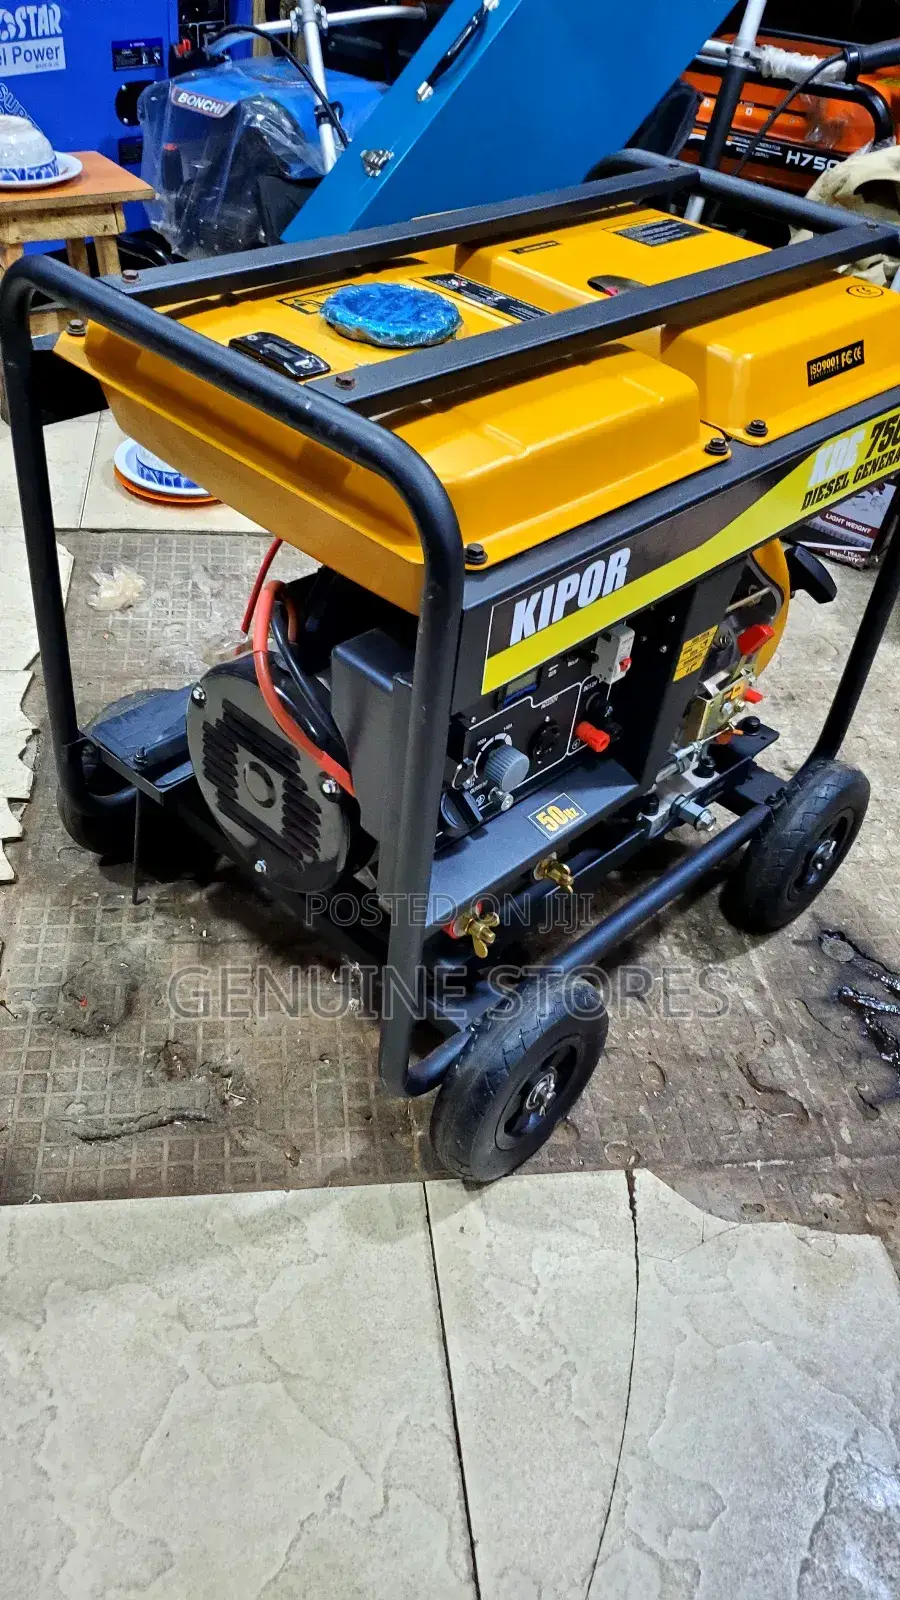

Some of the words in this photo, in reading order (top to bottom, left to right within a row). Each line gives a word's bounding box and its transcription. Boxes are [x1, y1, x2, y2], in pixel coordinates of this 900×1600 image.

[12, 45, 60, 65] Power
[178, 92, 223, 115] BONCHI
[810, 354, 840, 375] ISO9001
[801, 471, 850, 511] DIESEL
[825, 512, 846, 525] LIGHT
[845, 520, 872, 534] WEIGHT
[509, 547, 631, 647] KIPOR
[536, 805, 580, 832] 50Hz
